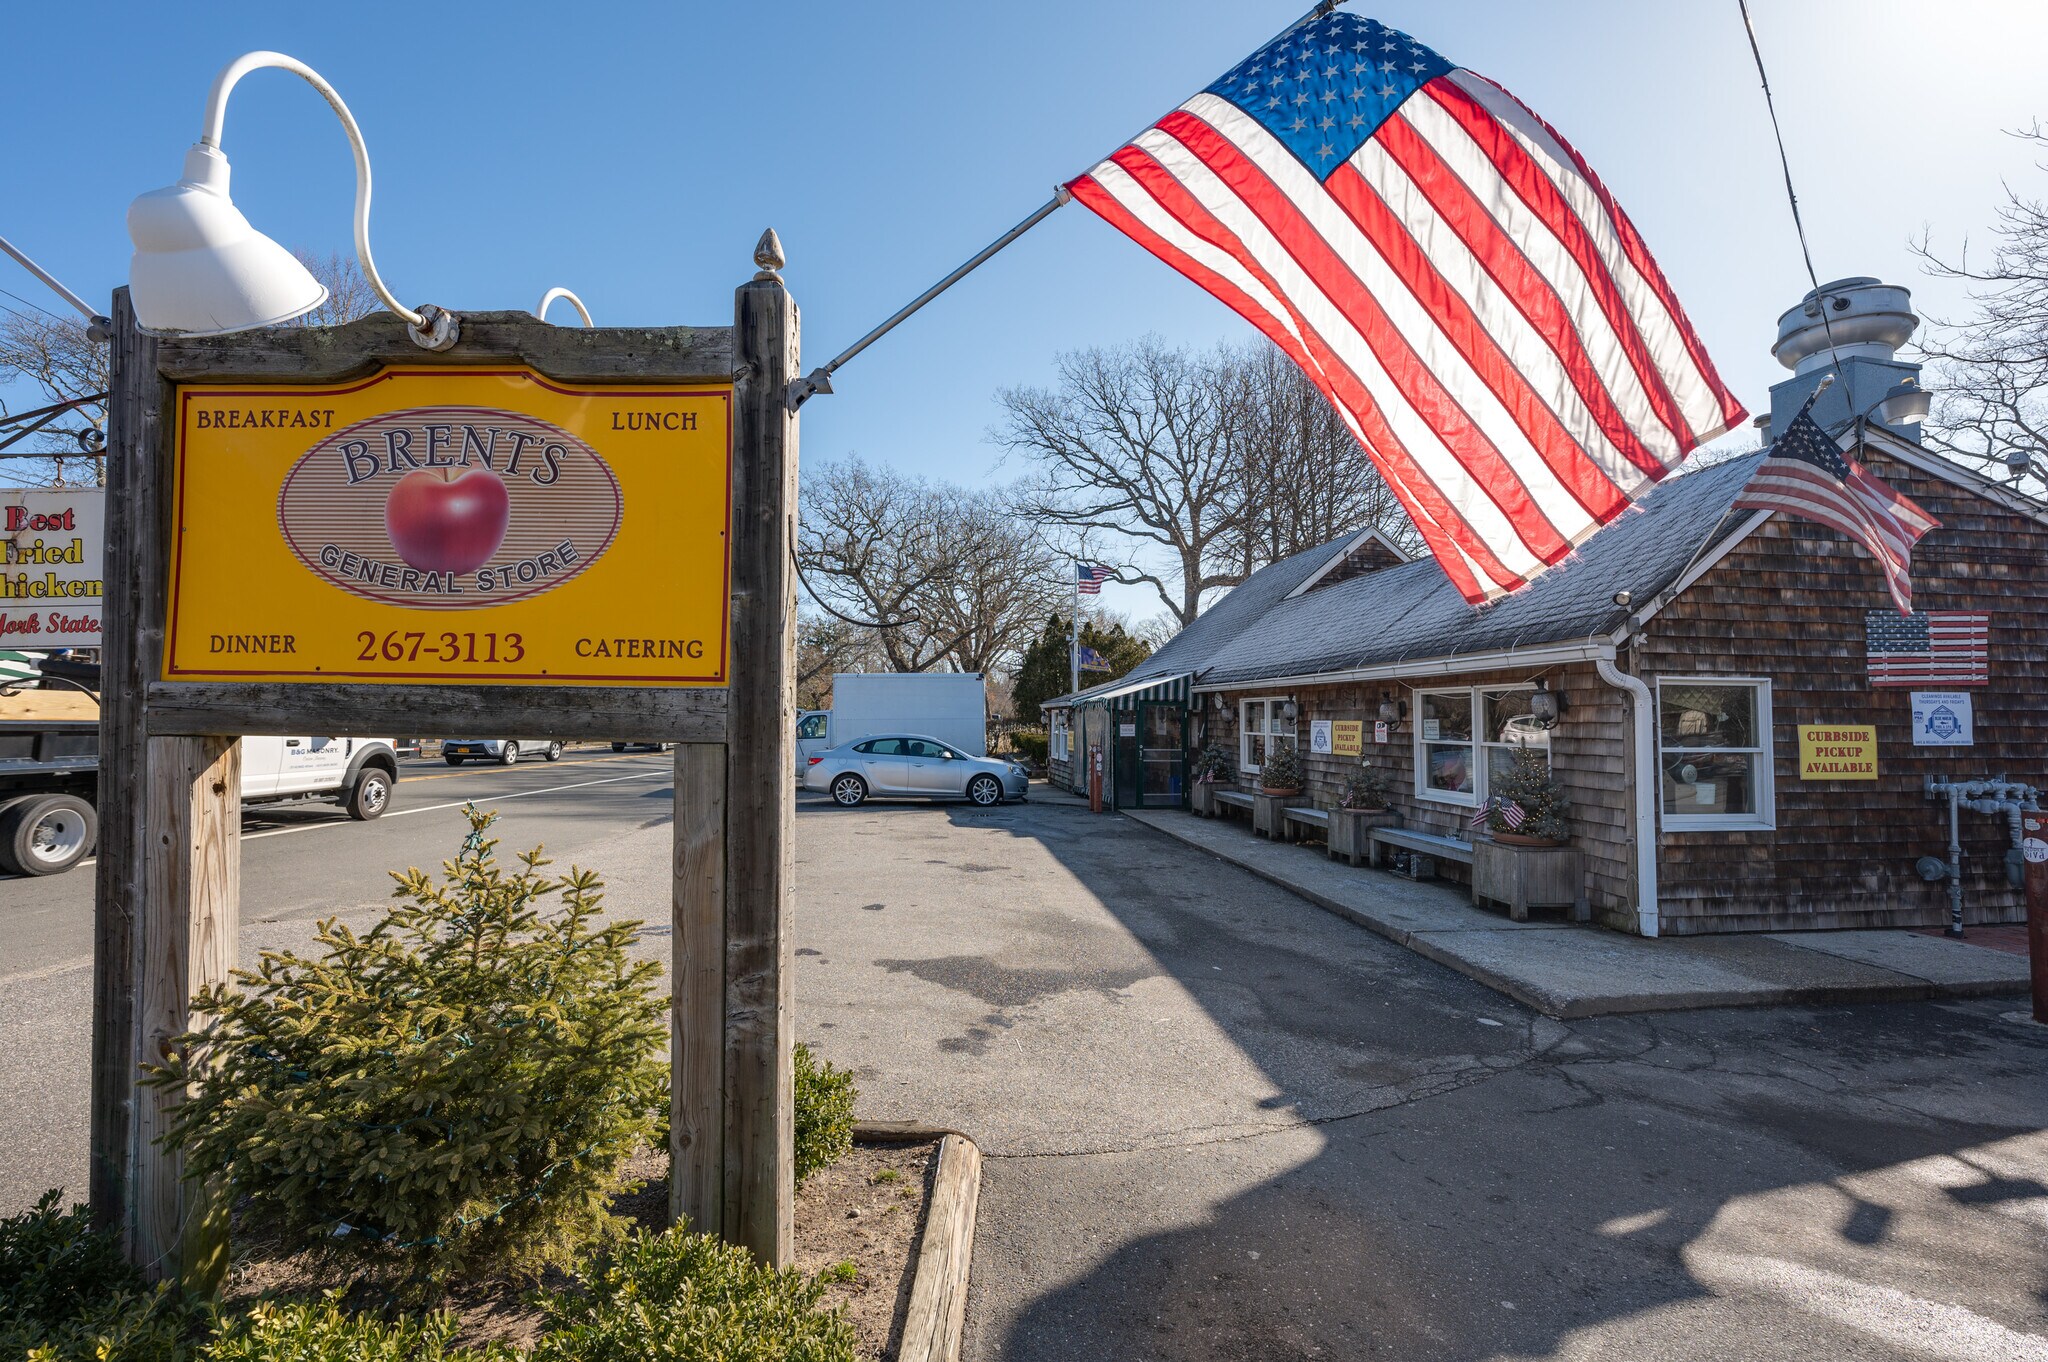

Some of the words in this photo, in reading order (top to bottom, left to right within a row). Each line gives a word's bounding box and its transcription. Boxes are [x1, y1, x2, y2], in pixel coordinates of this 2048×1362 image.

[197, 409, 336, 430] BREAKFAST
[612, 411, 698, 432] LUNCH
[336, 423, 569, 487] BRENT'S
[5, 505, 76, 532] Best
[0, 538, 84, 565] Fried
[318, 542, 464, 595] GENERAL
[475, 537, 581, 594] STORE
[0, 572, 103, 598] hicken
[210, 634, 297, 654] DINNER
[357, 630, 526, 663] 267-3113
[575, 638, 704, 659] CATERING
[1334, 724, 1359, 732] CURBSIDE
[1337, 734, 1356, 742] PICKUP
[1807, 731, 1870, 742] CURBSIDE
[1334, 744, 1360, 752] AVAILABLE
[1815, 746, 1863, 757] PICKUP
[1806, 762, 1873, 773] AVAILABLE
